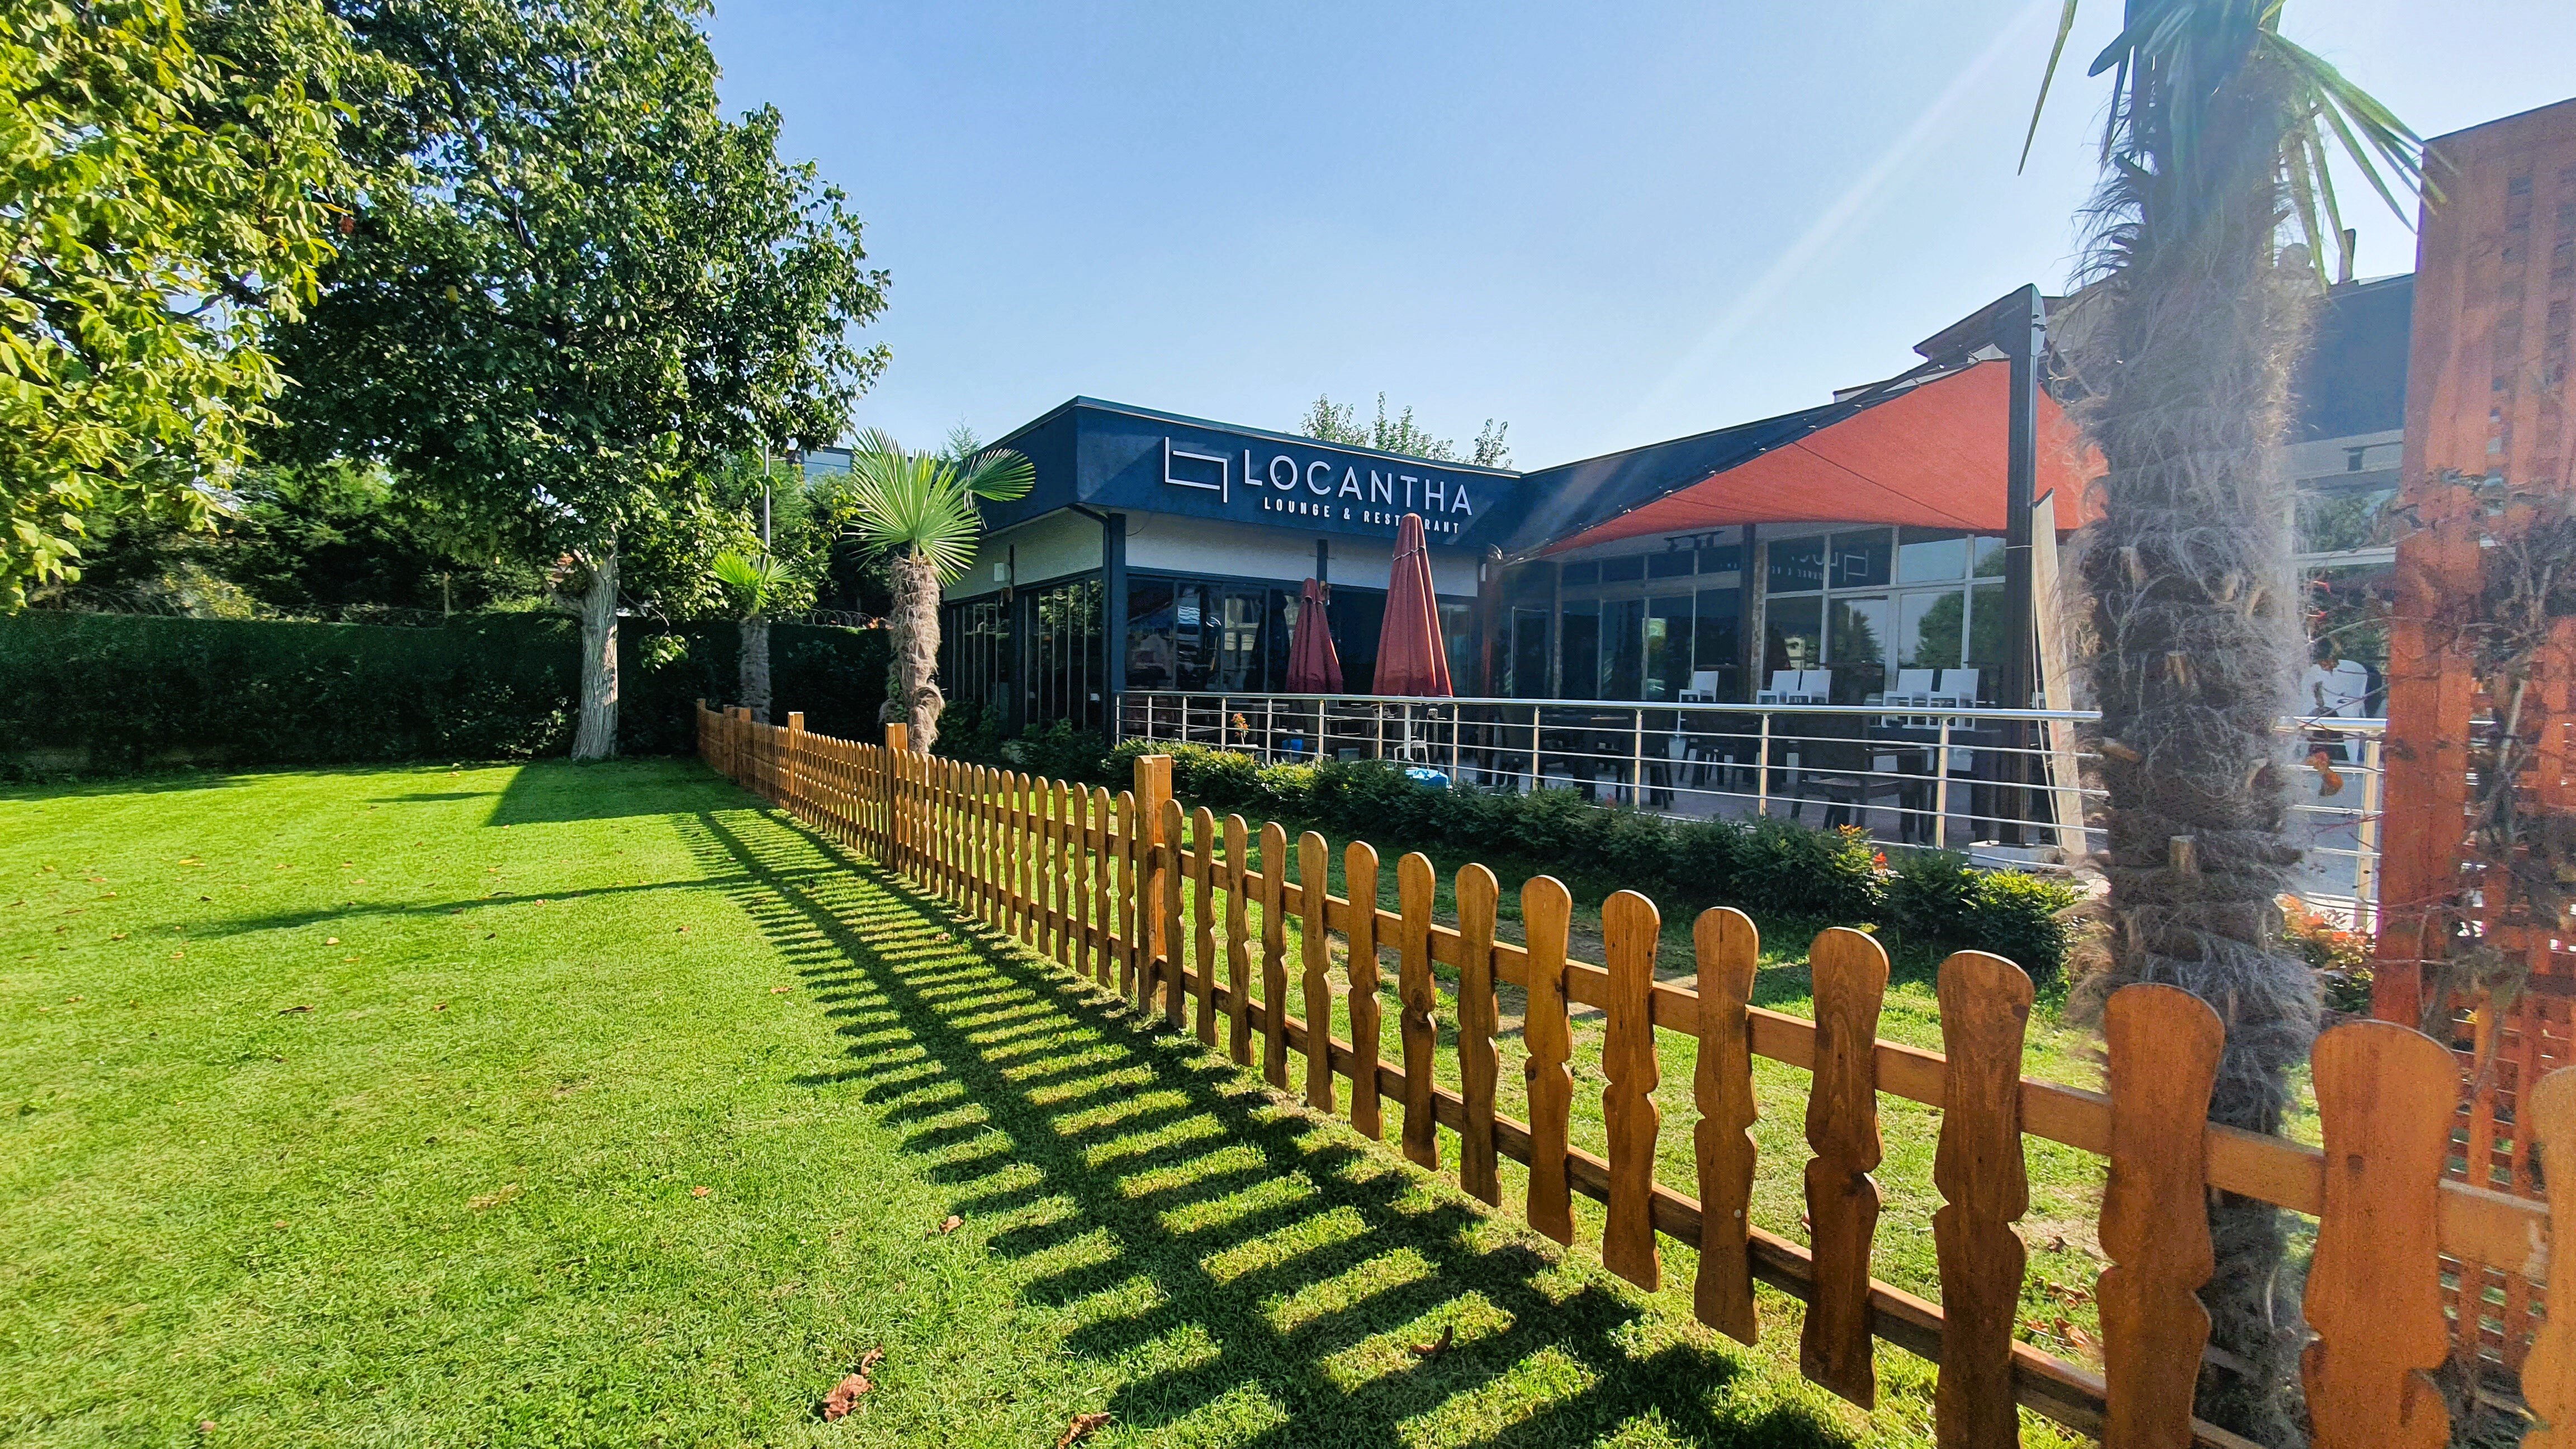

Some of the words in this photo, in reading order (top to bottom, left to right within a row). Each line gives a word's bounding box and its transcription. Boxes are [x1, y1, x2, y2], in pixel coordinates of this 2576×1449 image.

[1244, 449, 1472, 516] LOCANTHA
[1265, 496, 1330, 518] LOUNGE
[1343, 507, 1351, 520] &
[1363, 510, 1459, 534] RESTRANT
